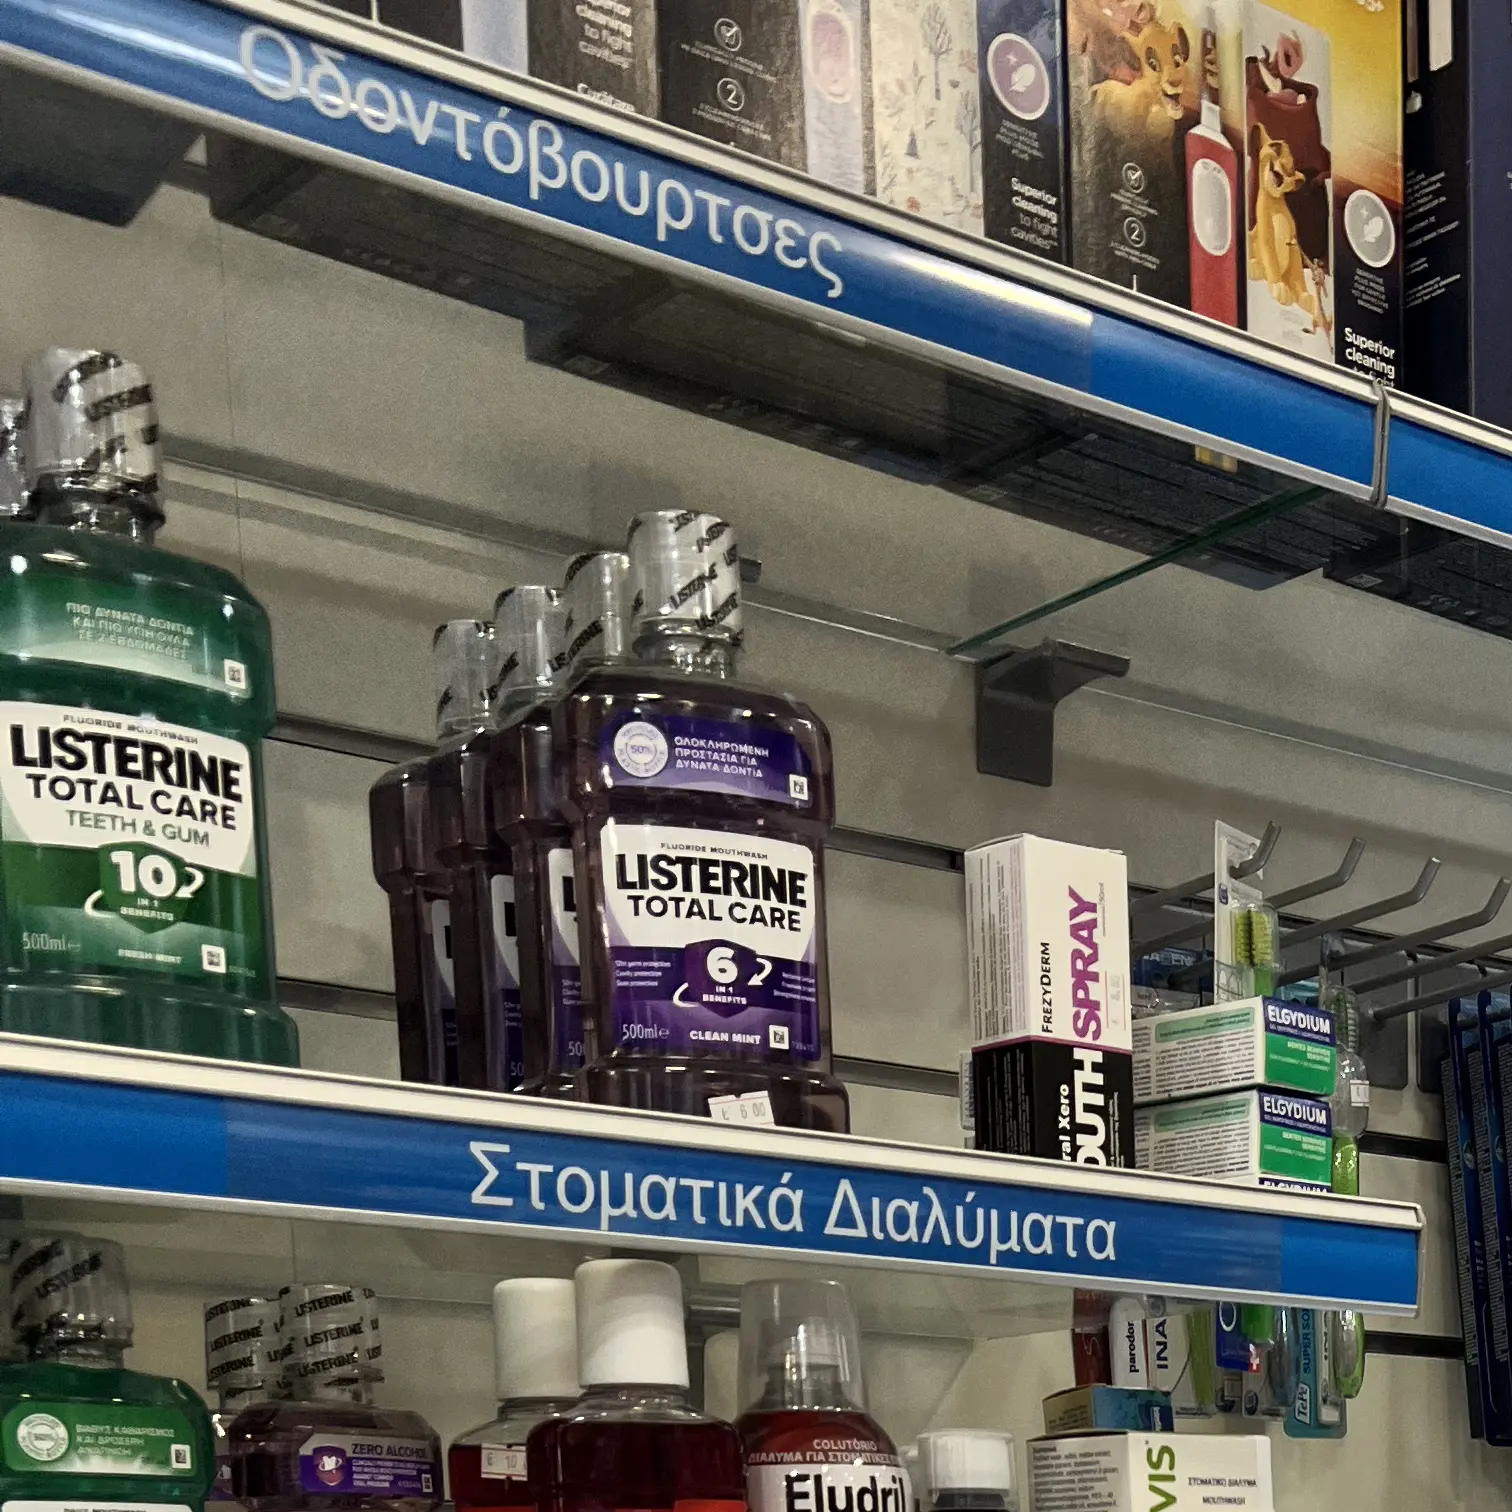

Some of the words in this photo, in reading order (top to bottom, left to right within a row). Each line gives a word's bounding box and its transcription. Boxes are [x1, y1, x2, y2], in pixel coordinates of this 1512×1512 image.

[239, 25, 845, 298] Οδοντόβουρτσες
[1345, 328, 1395, 360] Superior
[1346, 348, 1395, 379] cleaning
[10, 724, 243, 802] LISTERINE
[25, 773, 144, 810] TOTAL
[150, 789, 237, 831] CARE
[66, 808, 137, 835] TEETH
[141, 815, 157, 837] &
[161, 822, 210, 848] GUM
[660, 842, 707, 853] FLUORIDE
[710, 847, 768, 860] MOUTHWASH
[111, 849, 177, 898] 10
[615, 853, 807, 908] LISTERINE
[627, 895, 723, 922] TOTAL
[728, 902, 801, 932] CARE
[707, 947, 738, 984] 6
[1068, 885, 1102, 1041] SPRAY
[689, 1029, 729, 1042] CLEAN
[732, 1034, 761, 1046] MINT
[1268, 1004, 1331, 1035] ELGYDIUM
[1059, 1084, 1070, 1131] Xero
[1263, 1096, 1327, 1125] ELGYDIUM
[469, 1141, 804, 1234] Στοματικά
[824, 1179, 1117, 1264] Διαλύματα
[352, 1443, 384, 1456] ZERO
[386, 1446, 428, 1460] ALCOHOL
[813, 1437, 877, 1452] COLUTÓRIO
